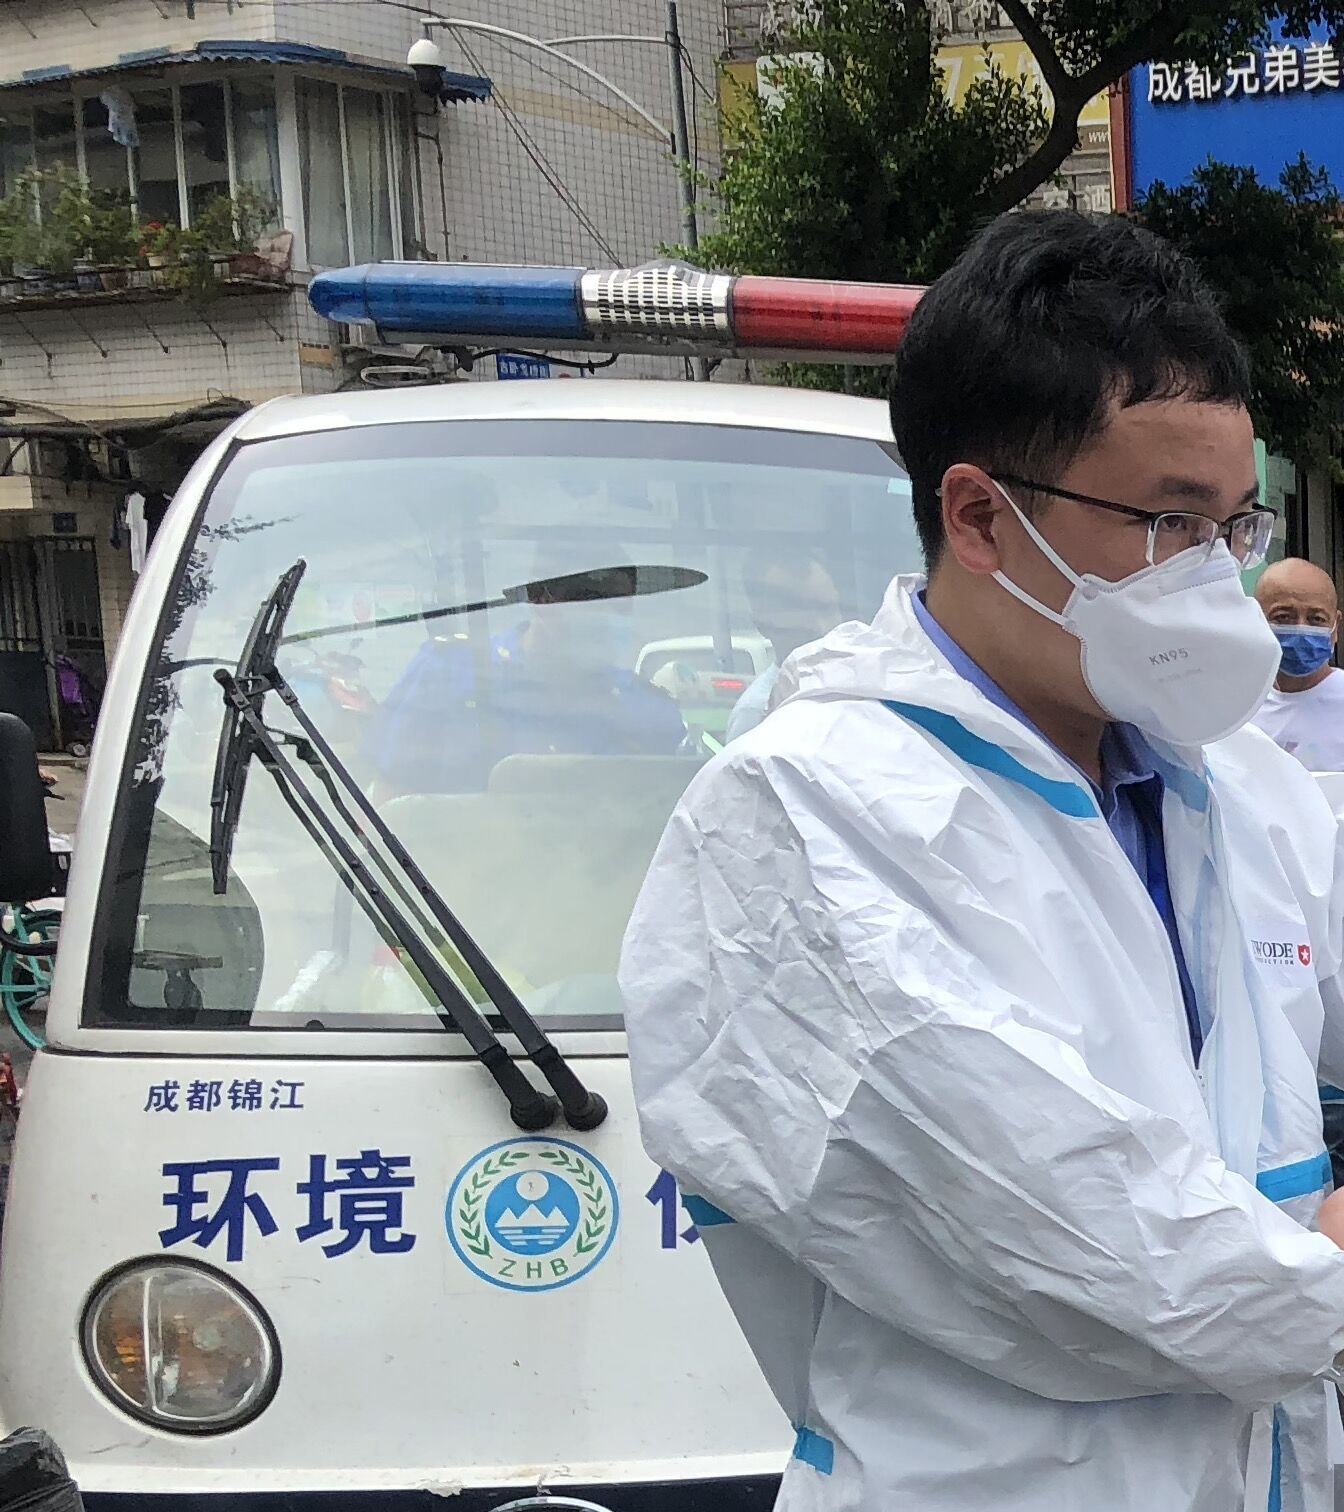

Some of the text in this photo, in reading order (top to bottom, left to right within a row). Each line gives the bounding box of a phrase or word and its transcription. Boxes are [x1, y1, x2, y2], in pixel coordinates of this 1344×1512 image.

[1148, 647, 1189, 666] KN95
[144, 1078, 306, 1113] 成都锦江
[498, 1257, 570, 1279] ZHB
